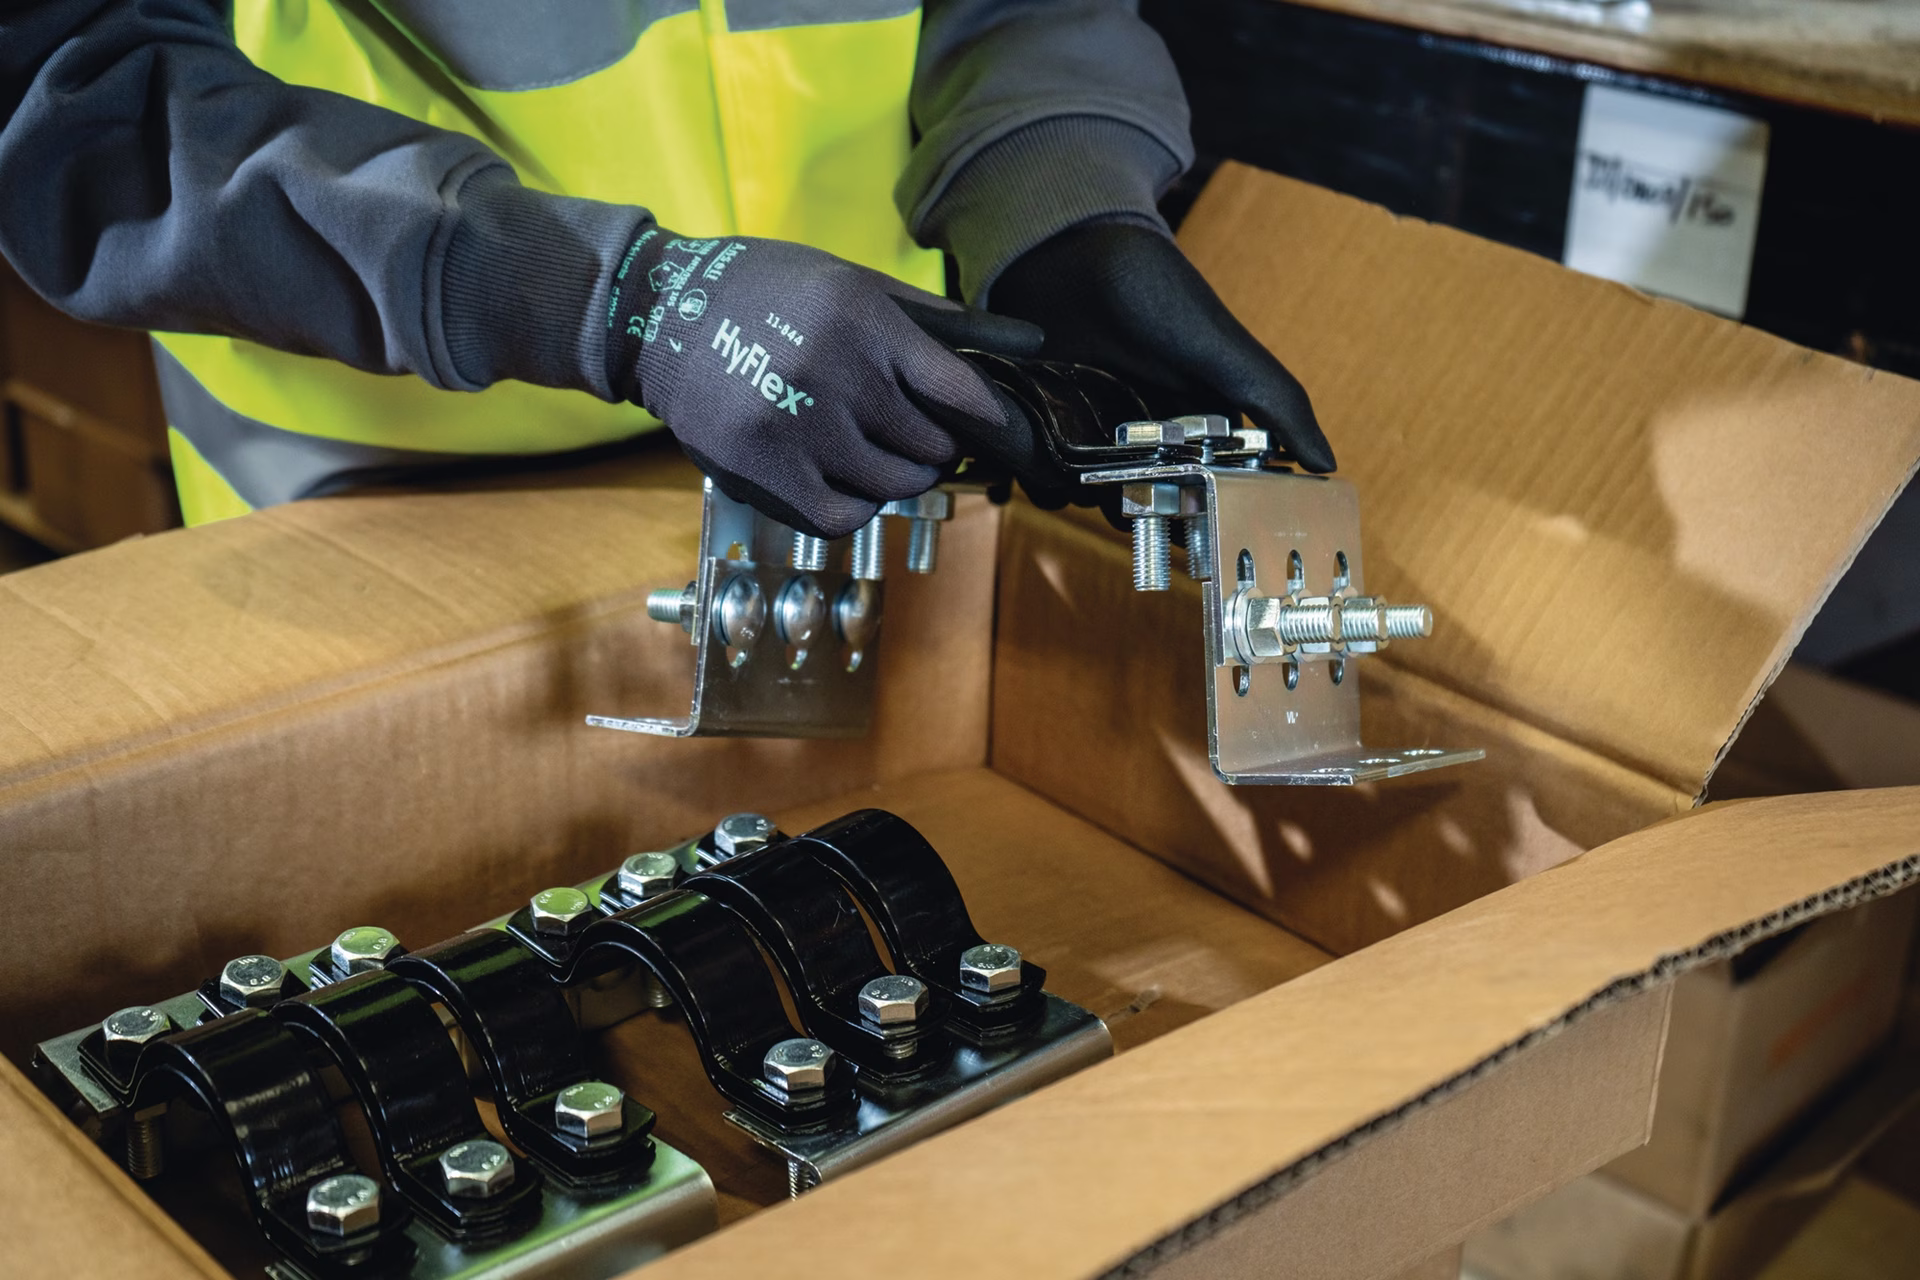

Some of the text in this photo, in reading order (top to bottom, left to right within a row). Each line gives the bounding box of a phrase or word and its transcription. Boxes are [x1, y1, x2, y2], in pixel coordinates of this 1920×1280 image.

[705, 242, 747, 281] Ansell
[666, 290, 680, 308] 105
[627, 316, 645, 338] CE
[765, 312, 804, 346] 11-844
